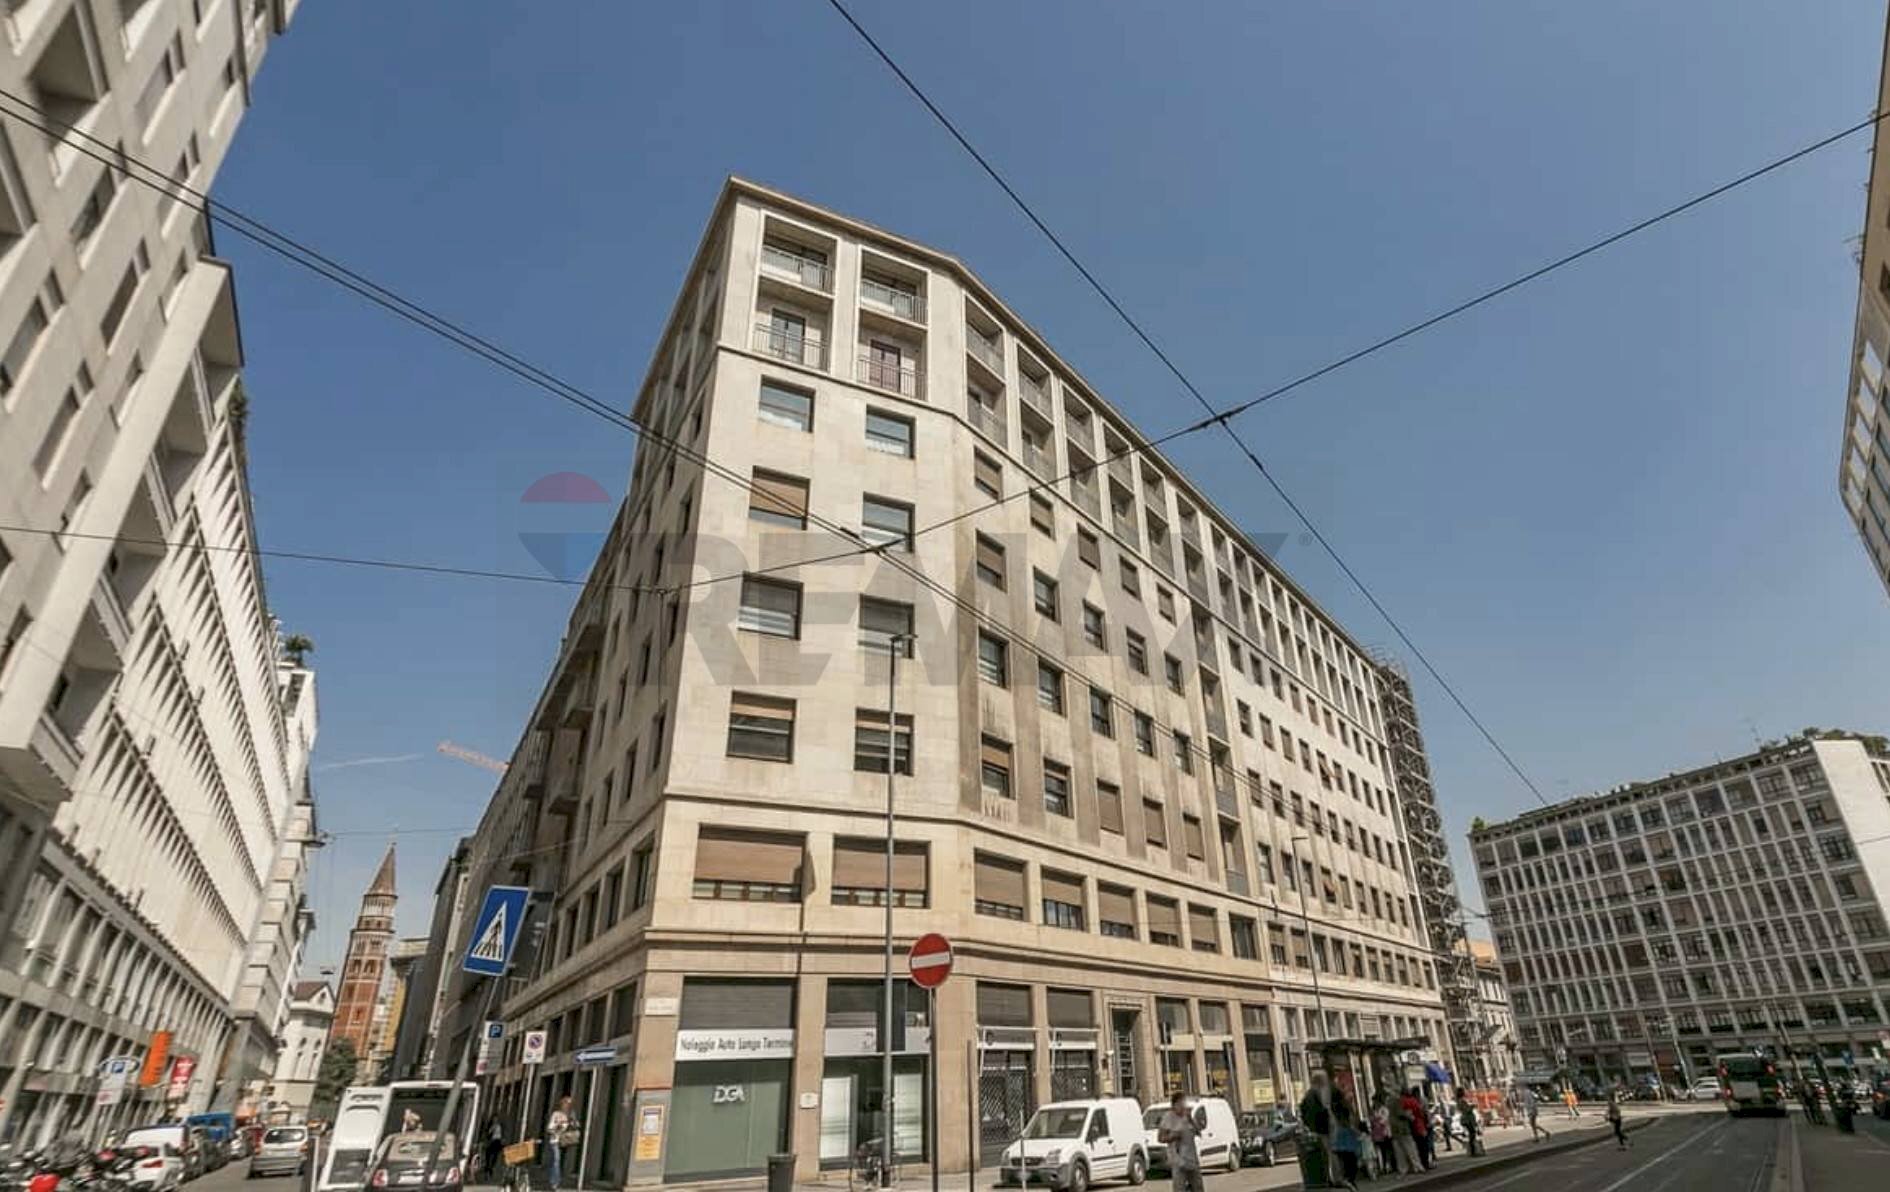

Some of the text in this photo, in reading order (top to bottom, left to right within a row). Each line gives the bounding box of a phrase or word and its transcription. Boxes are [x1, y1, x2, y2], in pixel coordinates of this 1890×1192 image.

[681, 1038, 715, 1053] Noleggio
[718, 1037, 736, 1050] Auto
[713, 1084, 745, 1103] DGA
